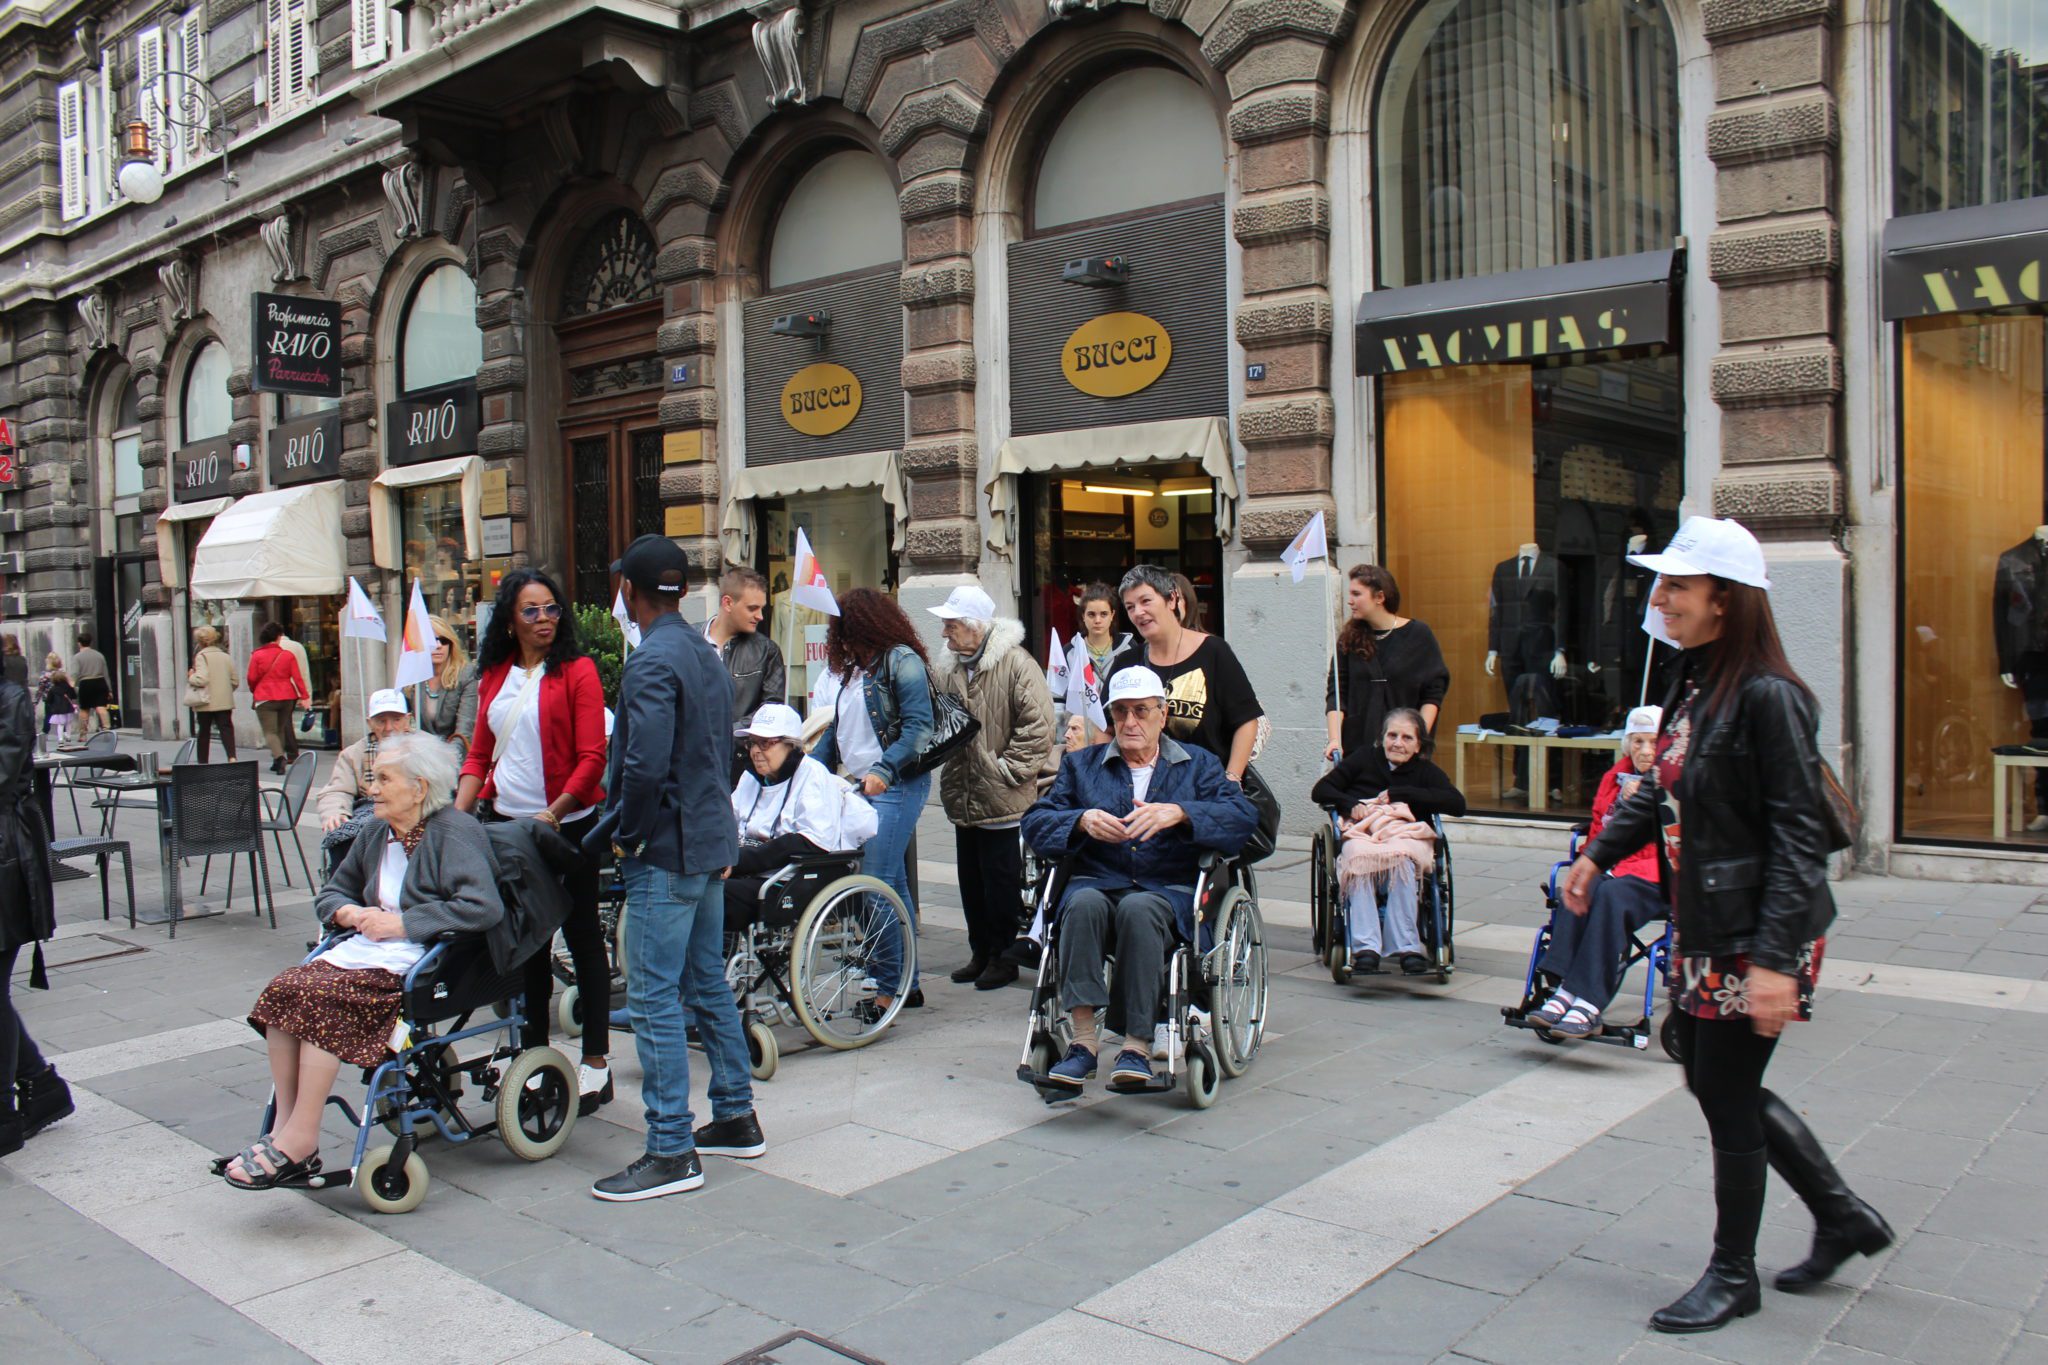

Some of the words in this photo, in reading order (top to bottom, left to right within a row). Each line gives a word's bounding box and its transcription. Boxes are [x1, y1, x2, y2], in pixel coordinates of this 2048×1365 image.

[267, 303, 331, 328] Profumeria
[266, 330, 331, 359] RAVO
[1073, 335, 1157, 371] BUCCI
[790, 384, 851, 415] BUCCI
[407, 399, 456, 446] RAVO
[284, 427, 325, 469] RAVO
[806, 642, 831, 662] FUO
